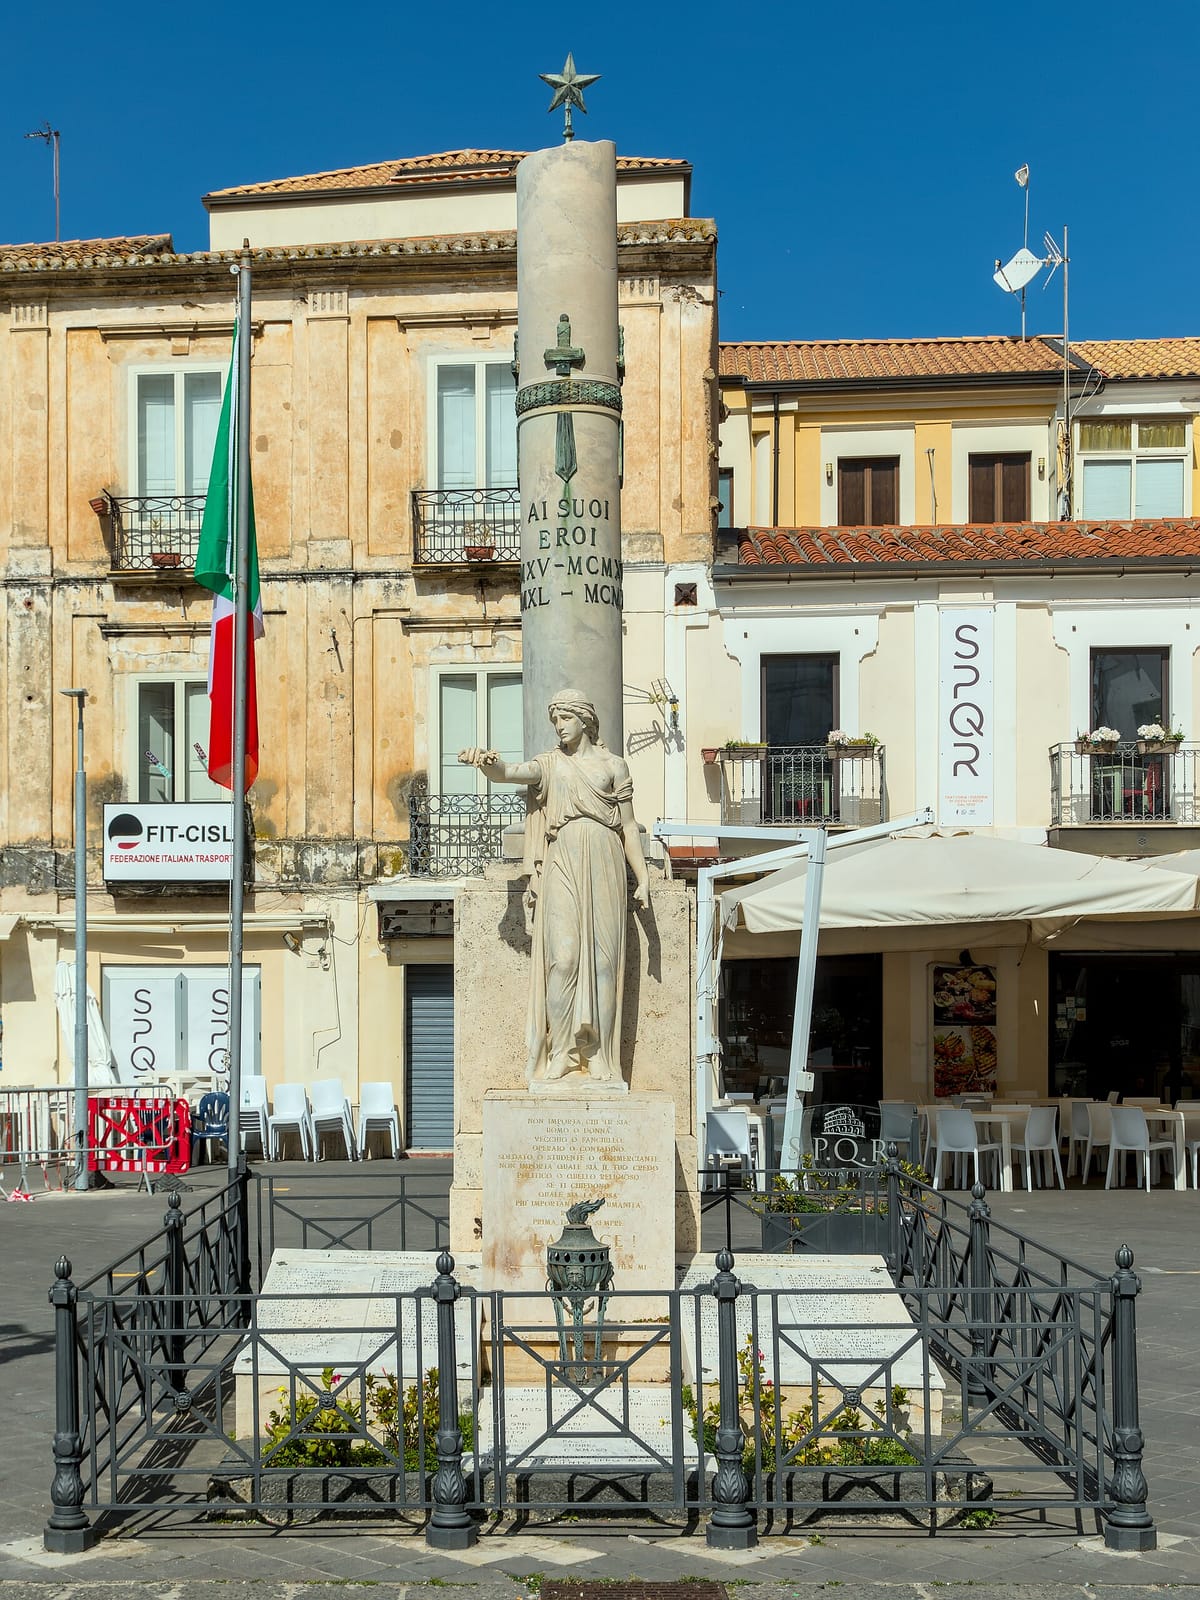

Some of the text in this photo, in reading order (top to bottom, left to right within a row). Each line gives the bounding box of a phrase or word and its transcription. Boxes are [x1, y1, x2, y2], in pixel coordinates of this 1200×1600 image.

[527, 499, 609, 524] AI SUOI
[539, 526, 597, 549] EROI
[949, 624, 984, 776] SPQR
[146, 825, 234, 842] FIT-CISL
[110, 855, 234, 863] FEDERAZIONE ITALIANA TRASPORT
